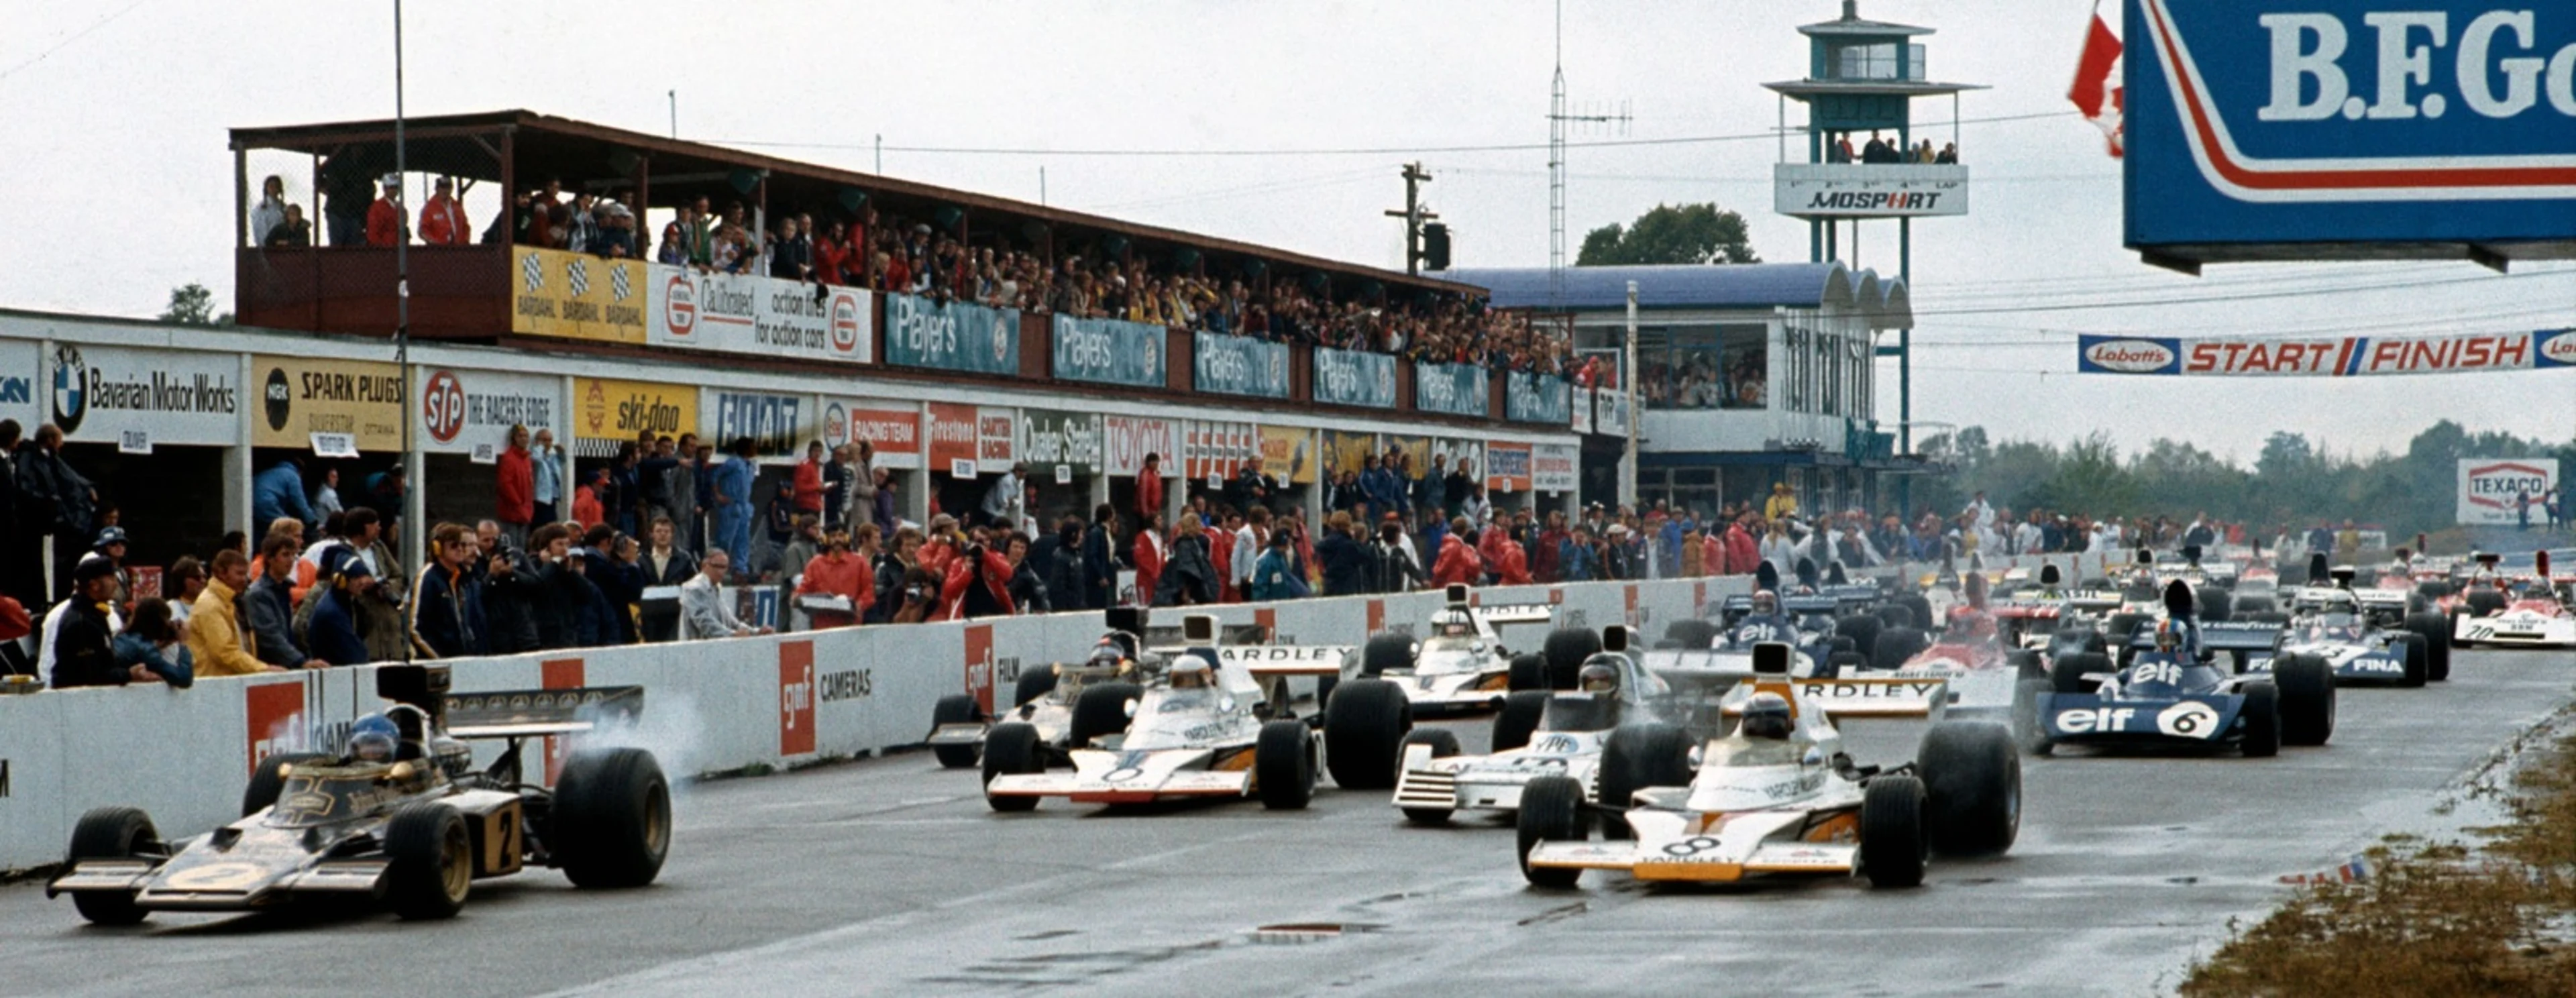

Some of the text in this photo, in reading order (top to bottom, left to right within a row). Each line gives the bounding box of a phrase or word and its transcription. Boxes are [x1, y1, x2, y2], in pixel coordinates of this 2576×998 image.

[702, 278, 754, 315] Calibrated
[773, 292, 803, 315] action
[755, 316, 825, 349] for action cars
[2094, 341, 2165, 364] Labatt's
[2187, 336, 2528, 372] START FINISH
[91, 368, 235, 414] Bavarian Motor Works
[268, 382, 288, 400] NGK
[302, 372, 402, 403] SPARK PLUGS
[427, 378, 462, 435] STP
[468, 394, 483, 424] THE
[526, 397, 549, 427] EDGE
[616, 394, 680, 433] ski-doo
[722, 401, 796, 449] FIAT
[854, 420, 914, 443] RACING TEAM
[928, 413, 973, 445] Firestone
[1024, 417, 1091, 464] Quaker State
[1108, 417, 1173, 469] TOYOTA
[2473, 478, 2542, 494] TEXACO
[2465, 624, 2494, 638] 20
[1222, 647, 1355, 662] ARDLEY
[2353, 659, 2403, 673] FINA
[998, 657, 1020, 683] FILM
[2132, 660, 2184, 687] elf
[820, 669, 871, 702] CAMERAS
[1804, 683, 1933, 698] RDLEY
[2055, 708, 2135, 732] elf
[2173, 711, 2208, 734] 6
[500, 810, 513, 869] 2
[1661, 836, 1721, 856] 8
